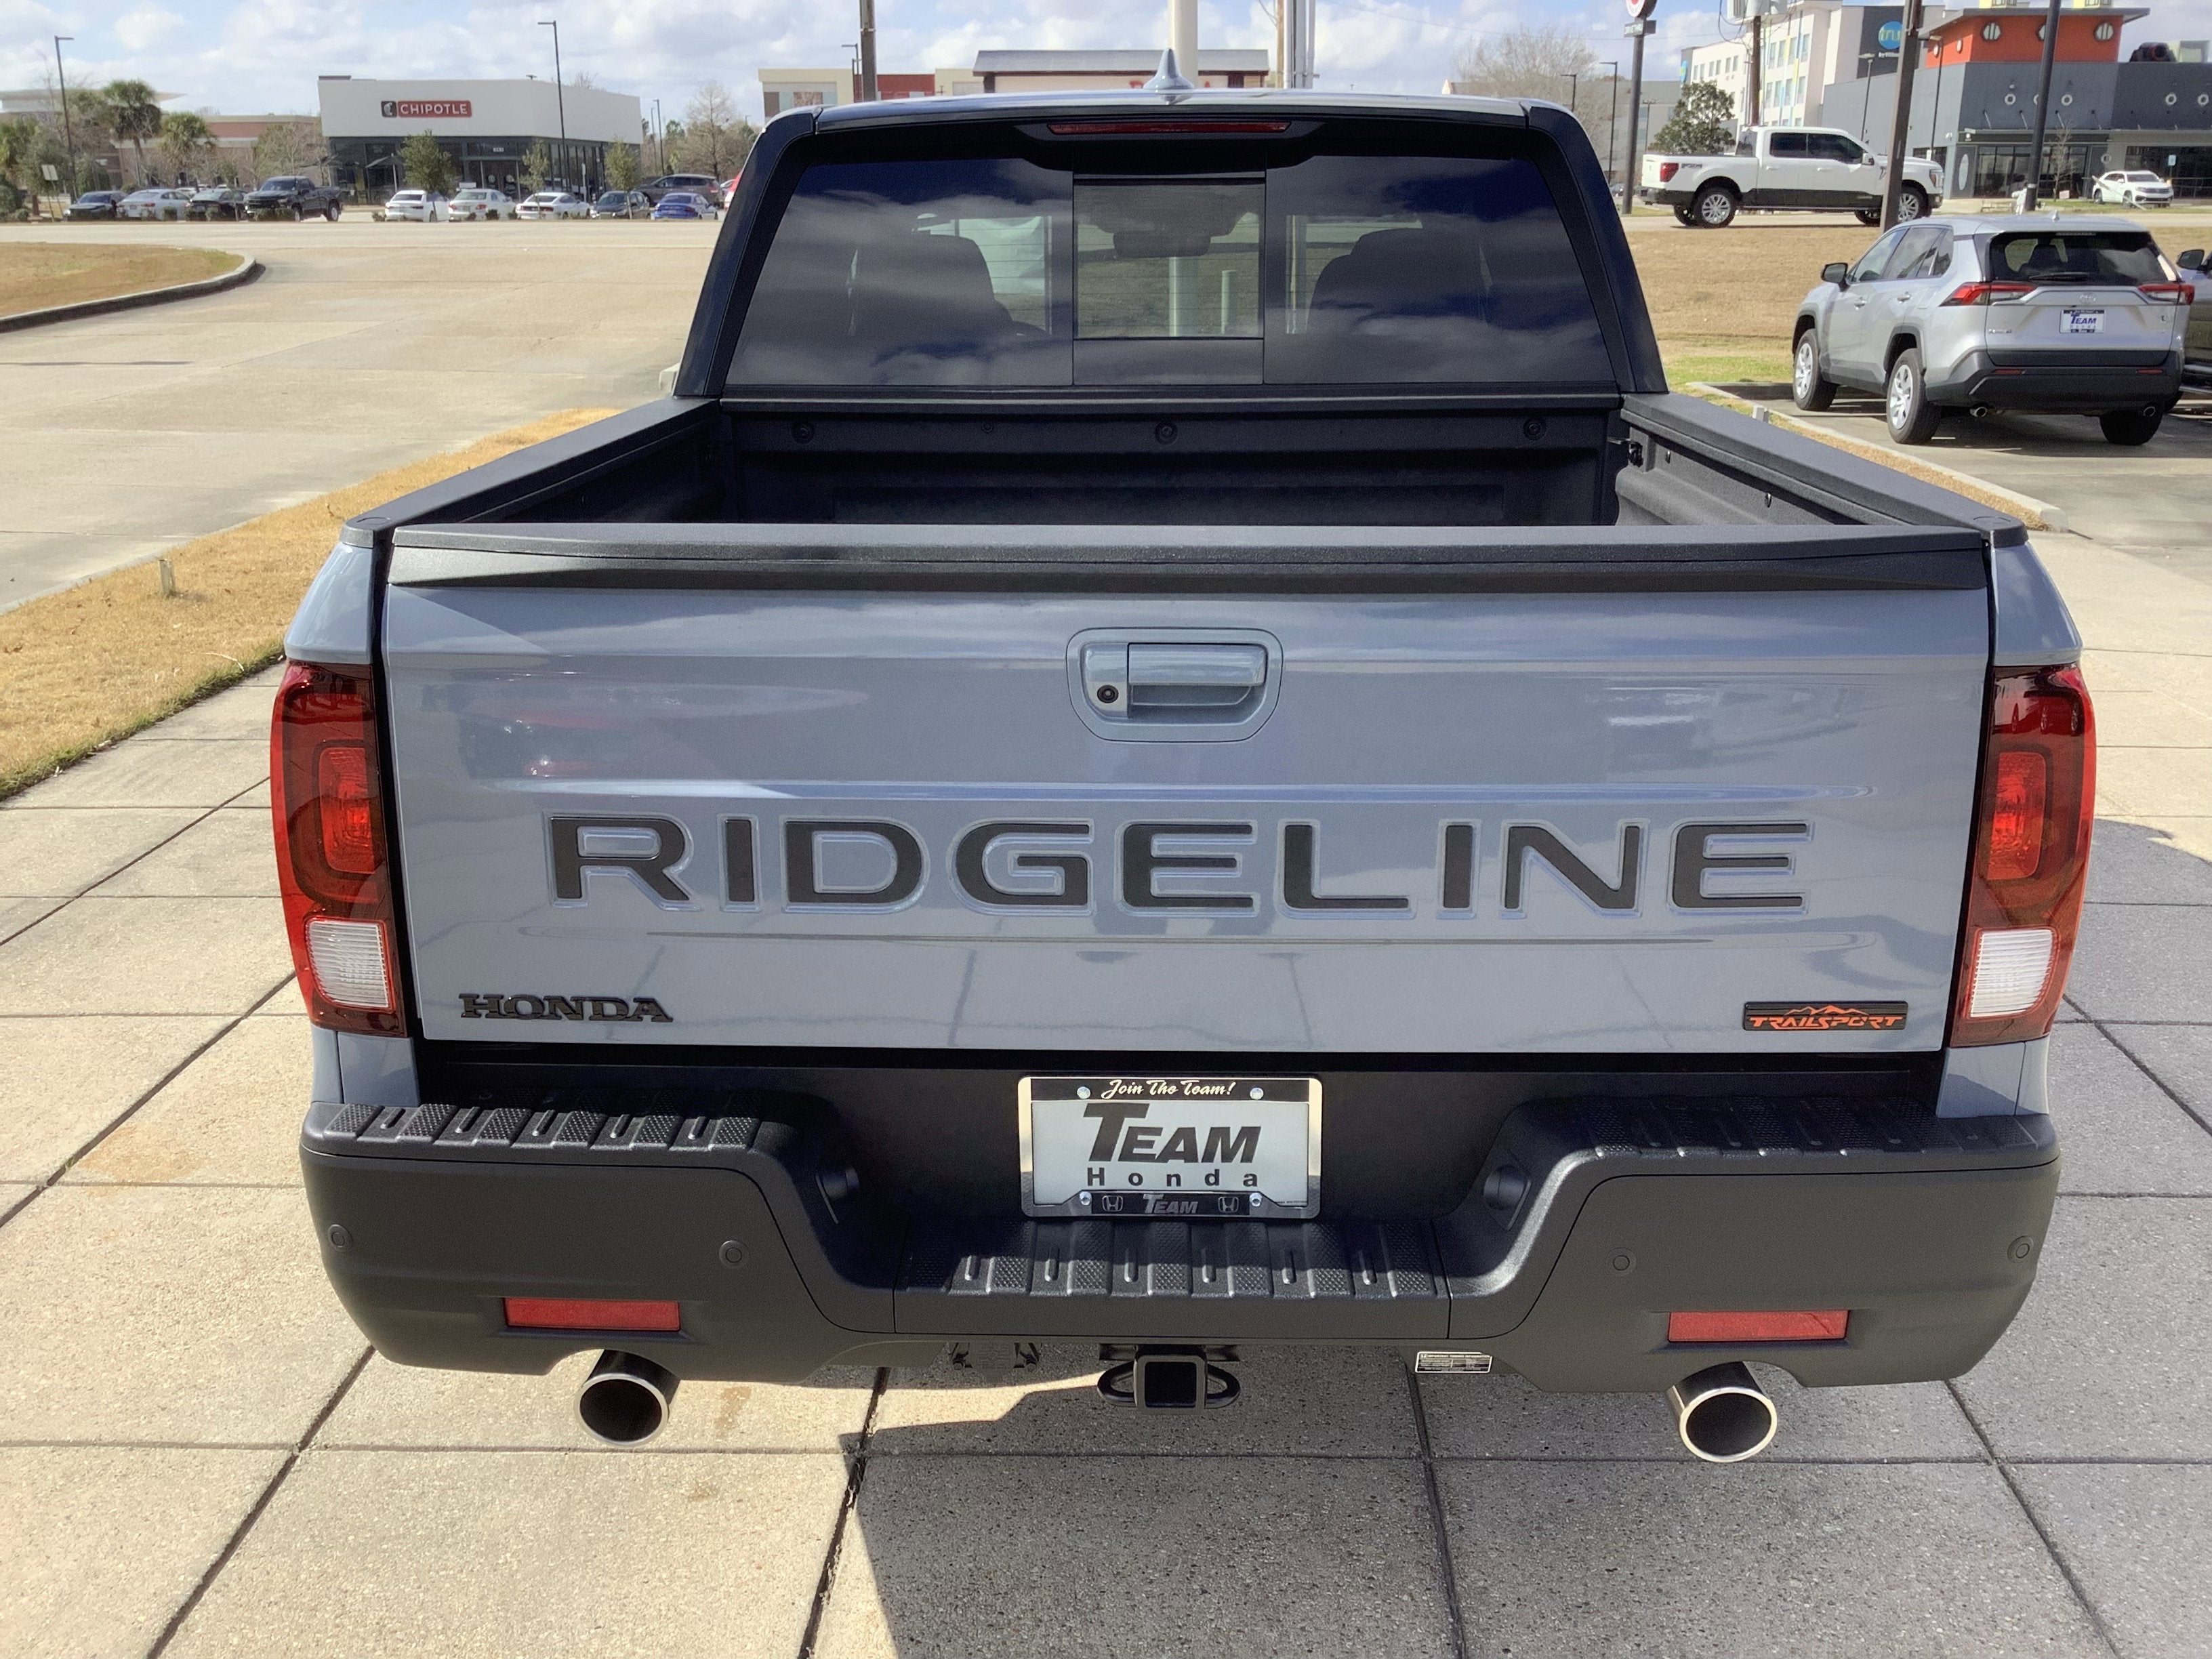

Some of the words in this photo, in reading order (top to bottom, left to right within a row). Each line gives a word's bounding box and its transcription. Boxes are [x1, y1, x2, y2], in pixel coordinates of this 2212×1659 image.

[400, 104, 468, 115] CHIPOTLE
[2071, 313, 2097, 324] TEAM
[548, 815, 1811, 912] RIDGELINE
[459, 994, 674, 1023] HONDA
[1750, 1016, 1903, 1029] TRAILSPORT
[1101, 1079, 1144, 1099] Join
[1146, 1080, 1179, 1095] The
[1180, 1080, 1237, 1096] Team!
[1083, 1103, 1262, 1164] TEAM
[1087, 1167, 1258, 1187] Honda
[1143, 1193, 1199, 1215] TEAM
